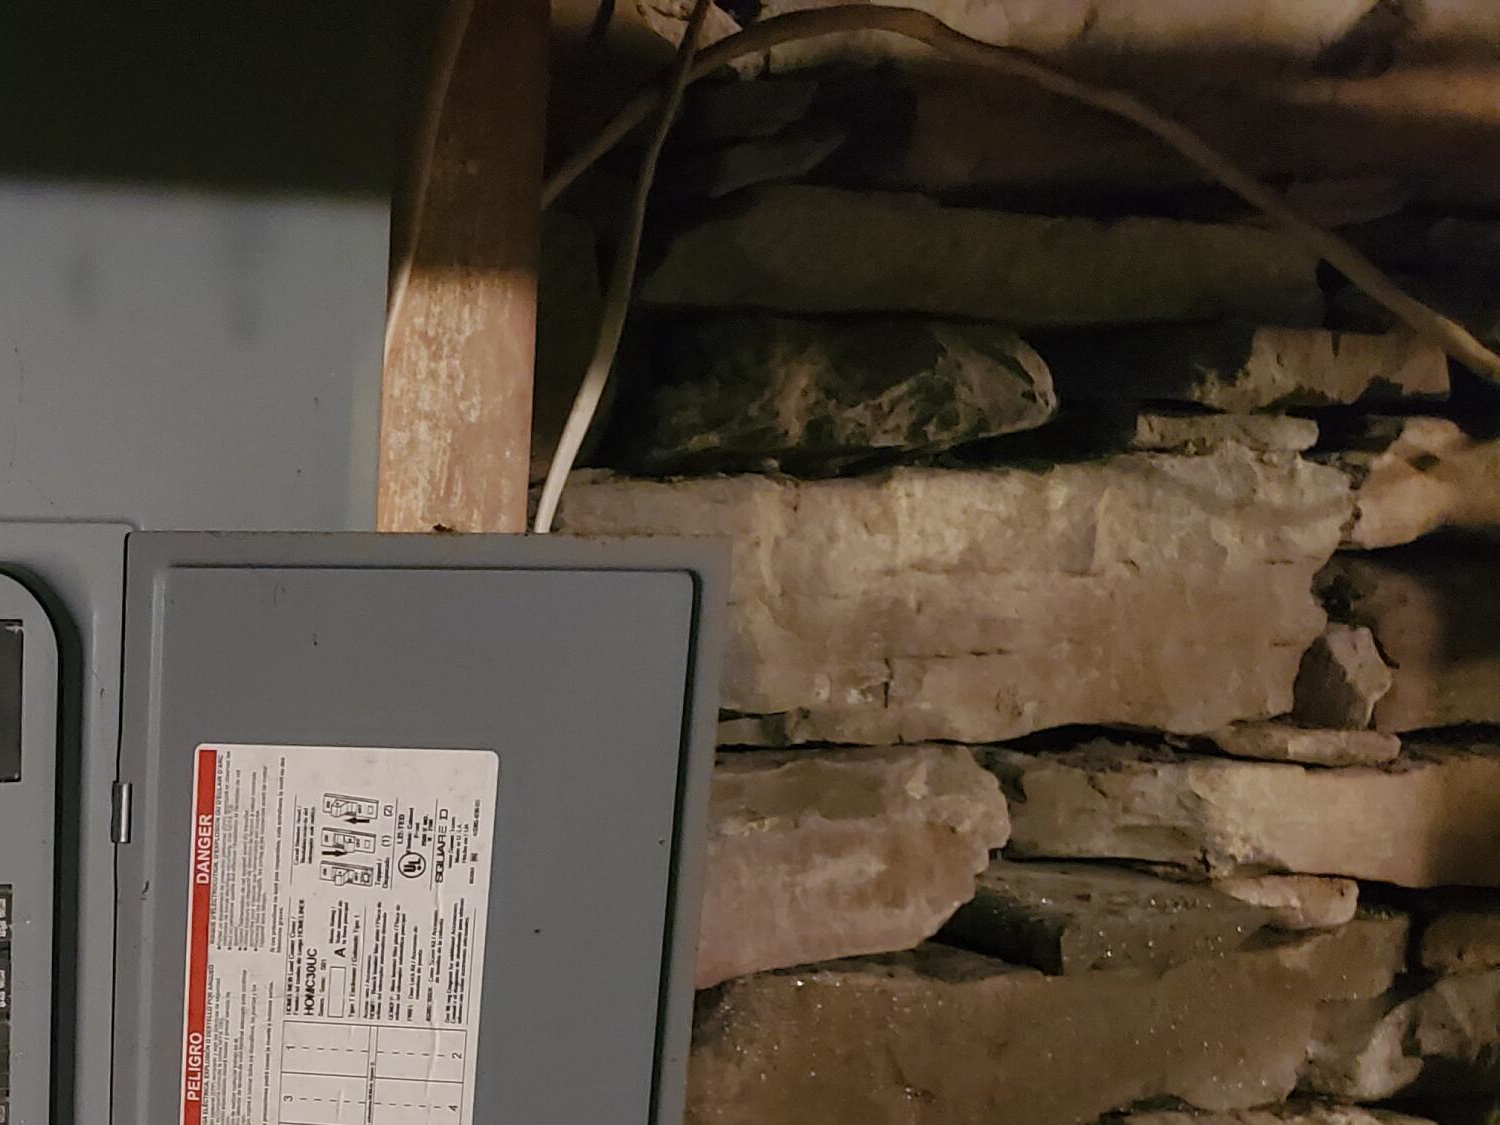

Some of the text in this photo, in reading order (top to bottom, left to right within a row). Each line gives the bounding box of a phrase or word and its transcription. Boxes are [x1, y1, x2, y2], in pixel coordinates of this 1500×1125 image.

[383, 805, 394, 817] (2)
[397, 814, 405, 844] LISTED
[196, 814, 212, 884] DANGER
[381, 835, 391, 847] (1)
[435, 809, 448, 883] SQUARE D
[334, 948, 346, 958] A
[304, 948, 317, 1016] HOMC30UC
[187, 1033, 202, 1101] PELIGRO
